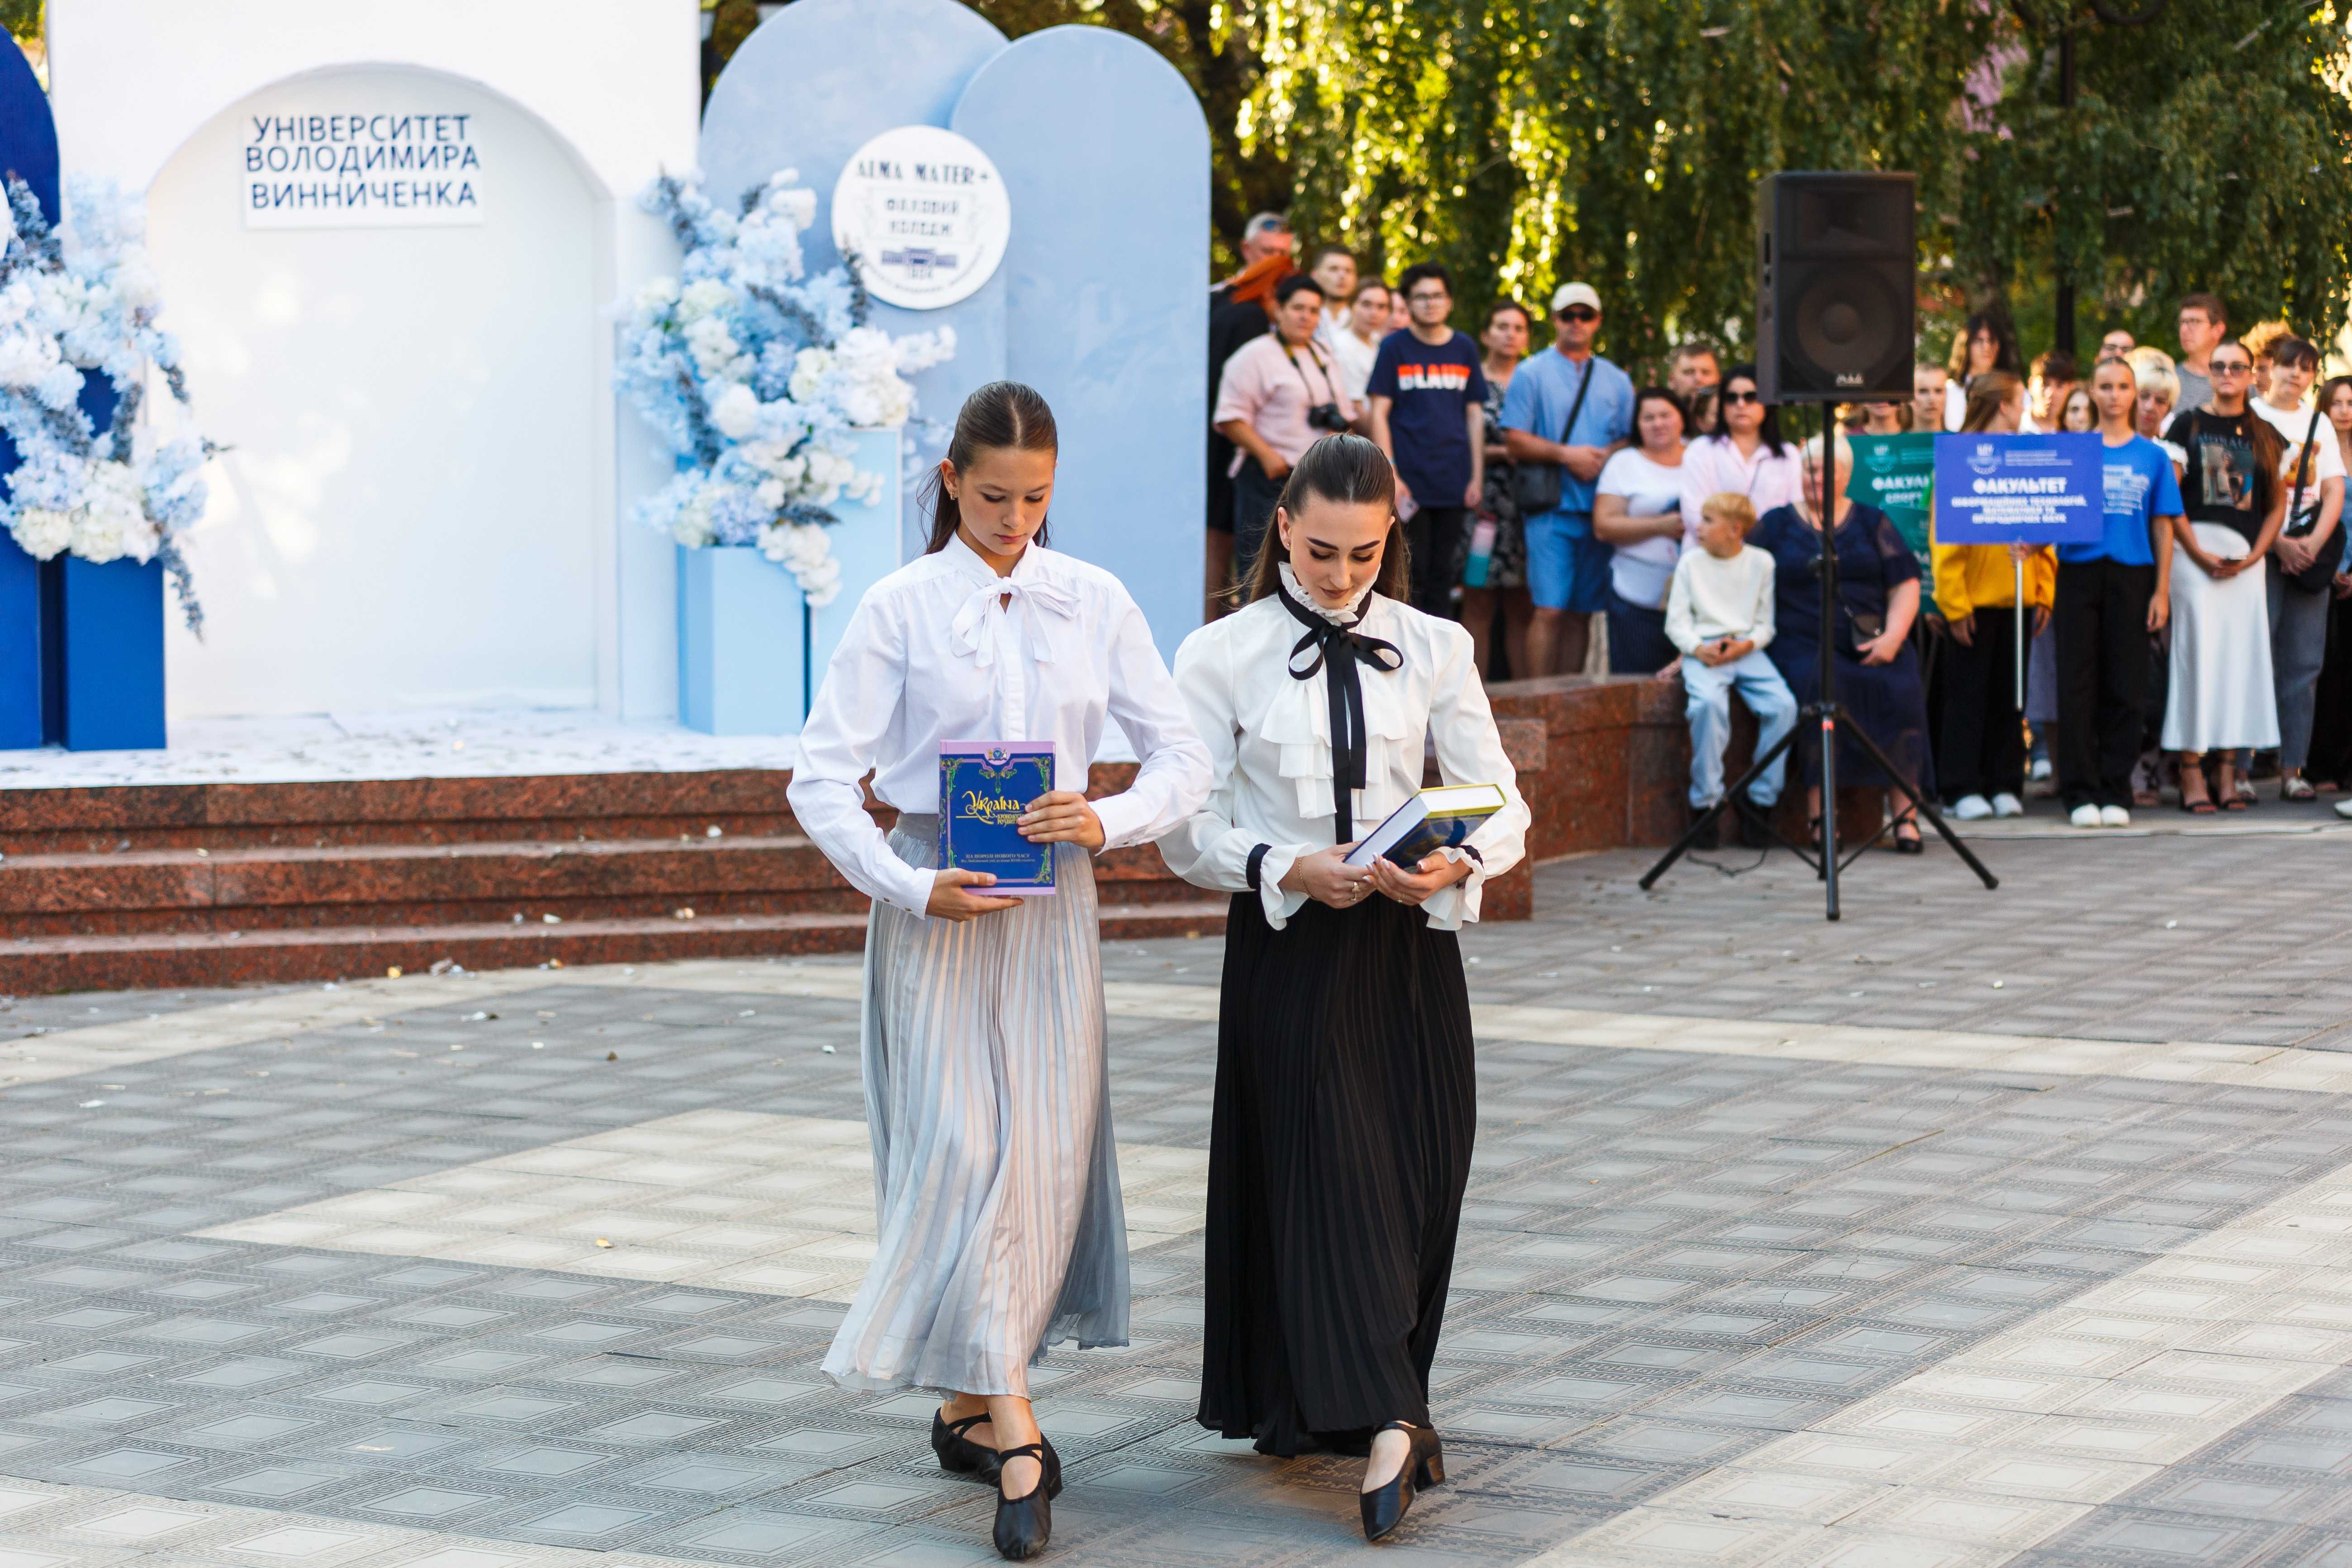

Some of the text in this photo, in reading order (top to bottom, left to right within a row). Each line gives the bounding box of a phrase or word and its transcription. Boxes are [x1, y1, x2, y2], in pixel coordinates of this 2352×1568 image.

[253, 115, 470, 142] УНІВЕРСИТЕТ
[247, 145, 480, 178] ВОЛОДИМИРА
[252, 181, 476, 208] ВИННИЧЕНКА
[1973, 477, 2067, 494] ФАКУЛЬТЕТ
